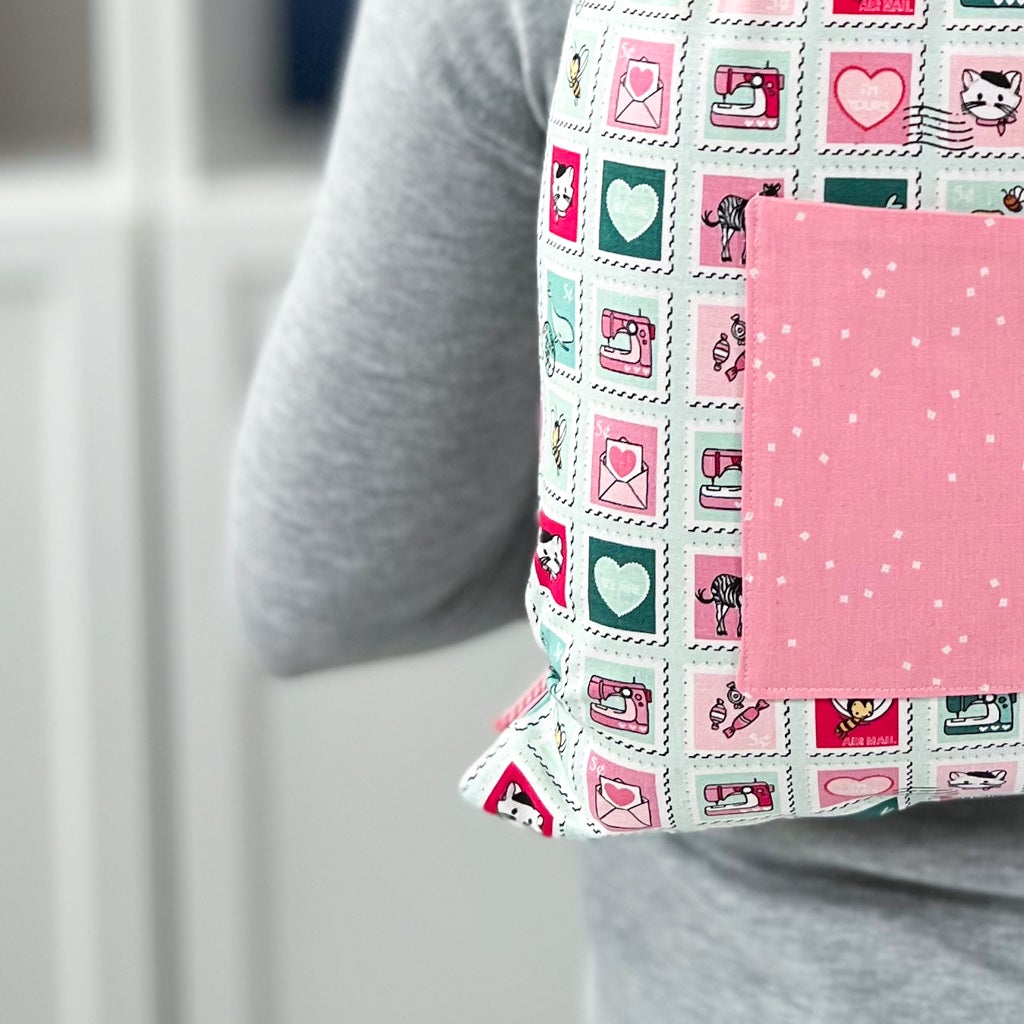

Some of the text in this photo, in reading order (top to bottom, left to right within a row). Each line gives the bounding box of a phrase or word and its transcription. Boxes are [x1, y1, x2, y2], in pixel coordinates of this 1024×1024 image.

[859, 0, 913, 12] AIR MAIL
[597, 420, 611, 439] 5¢
[842, 735, 897, 747] AIR MAIL
[589, 756, 606, 774] 5¢
